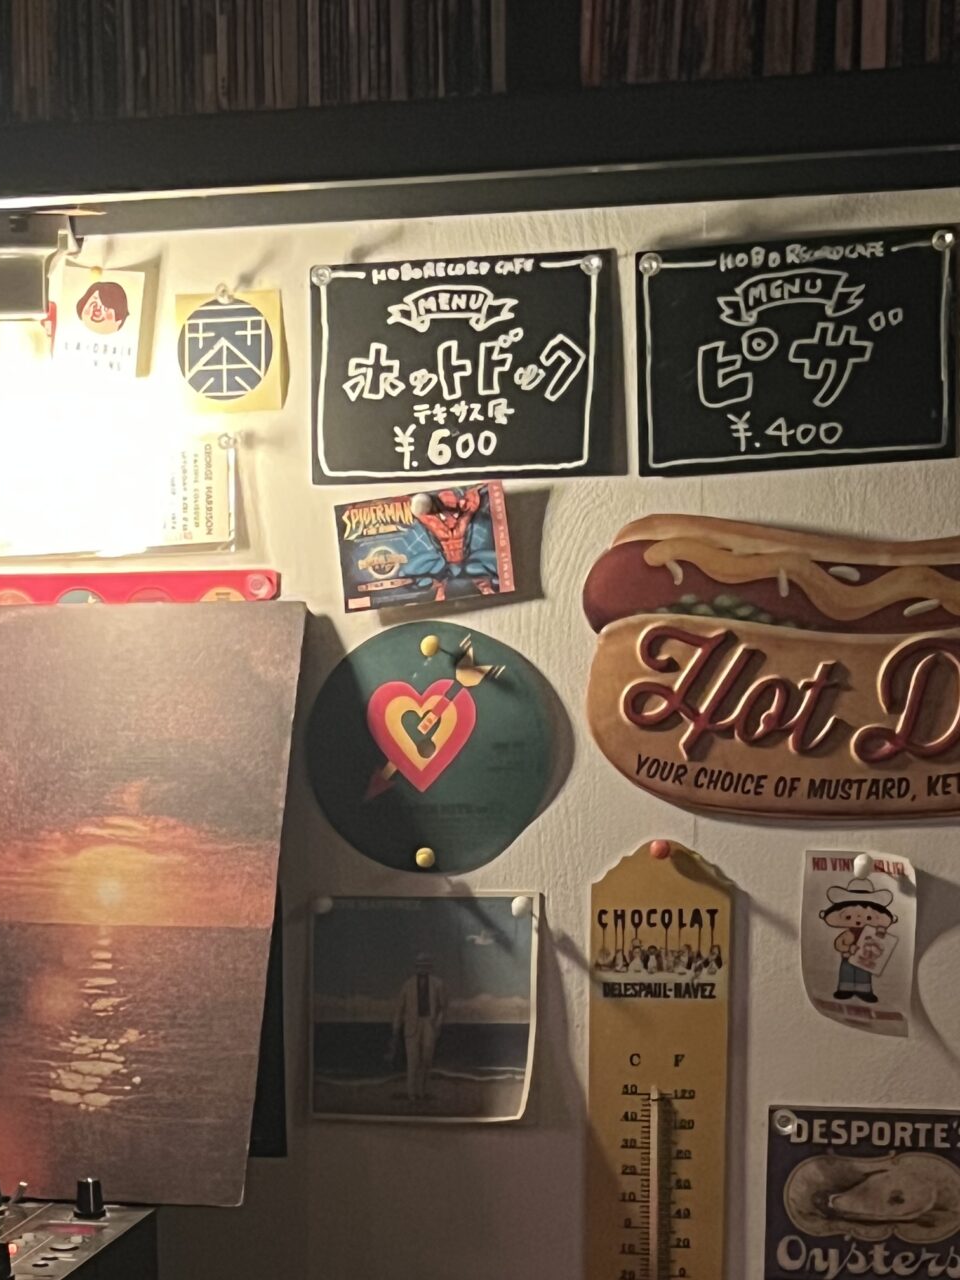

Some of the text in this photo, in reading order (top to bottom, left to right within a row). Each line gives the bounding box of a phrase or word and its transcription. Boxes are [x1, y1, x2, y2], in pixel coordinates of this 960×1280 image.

[418, 293, 484, 315] MENU
[748, 278, 822, 306] MENU
[697, 307, 903, 408] ピザ
[619, 623, 840, 762] Hot
[636, 753, 688, 786] YOUR
[694, 767, 767, 796] CHOICE
[774, 776, 801, 798] OF
[807, 777, 918, 801] MUSTARD,
[598, 908, 718, 929] CHOCOLAT
[630, 1053, 685, 1067] C F
[790, 1118, 960, 1148] DESPORTE'
